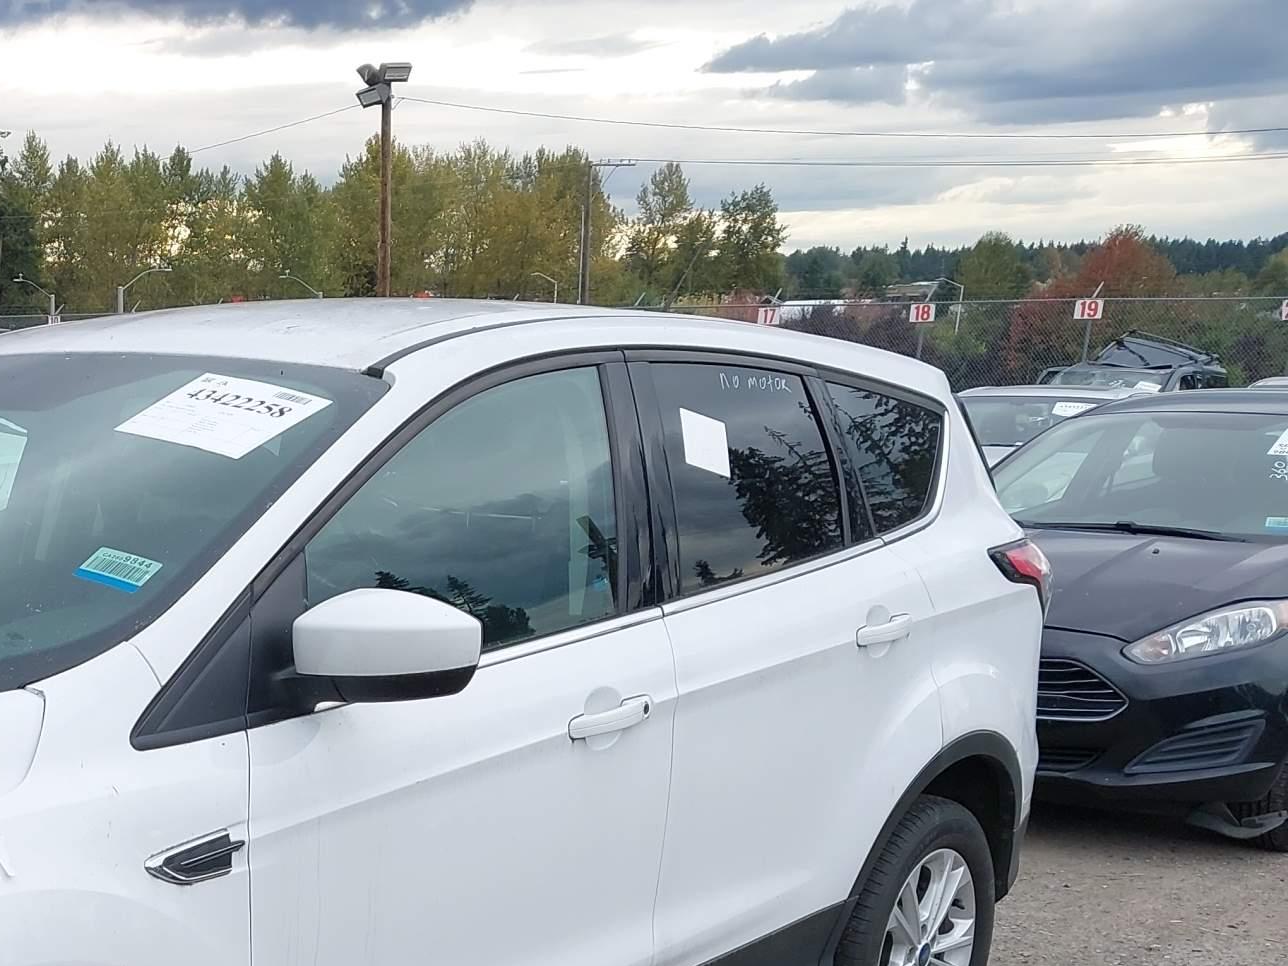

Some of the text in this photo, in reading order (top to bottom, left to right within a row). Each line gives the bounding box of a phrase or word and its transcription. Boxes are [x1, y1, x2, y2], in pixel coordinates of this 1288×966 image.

[763, 308, 777, 324] 17
[914, 304, 931, 321] 18
[1080, 300, 1099, 318] 19
[187, 388, 293, 418] 43422258
